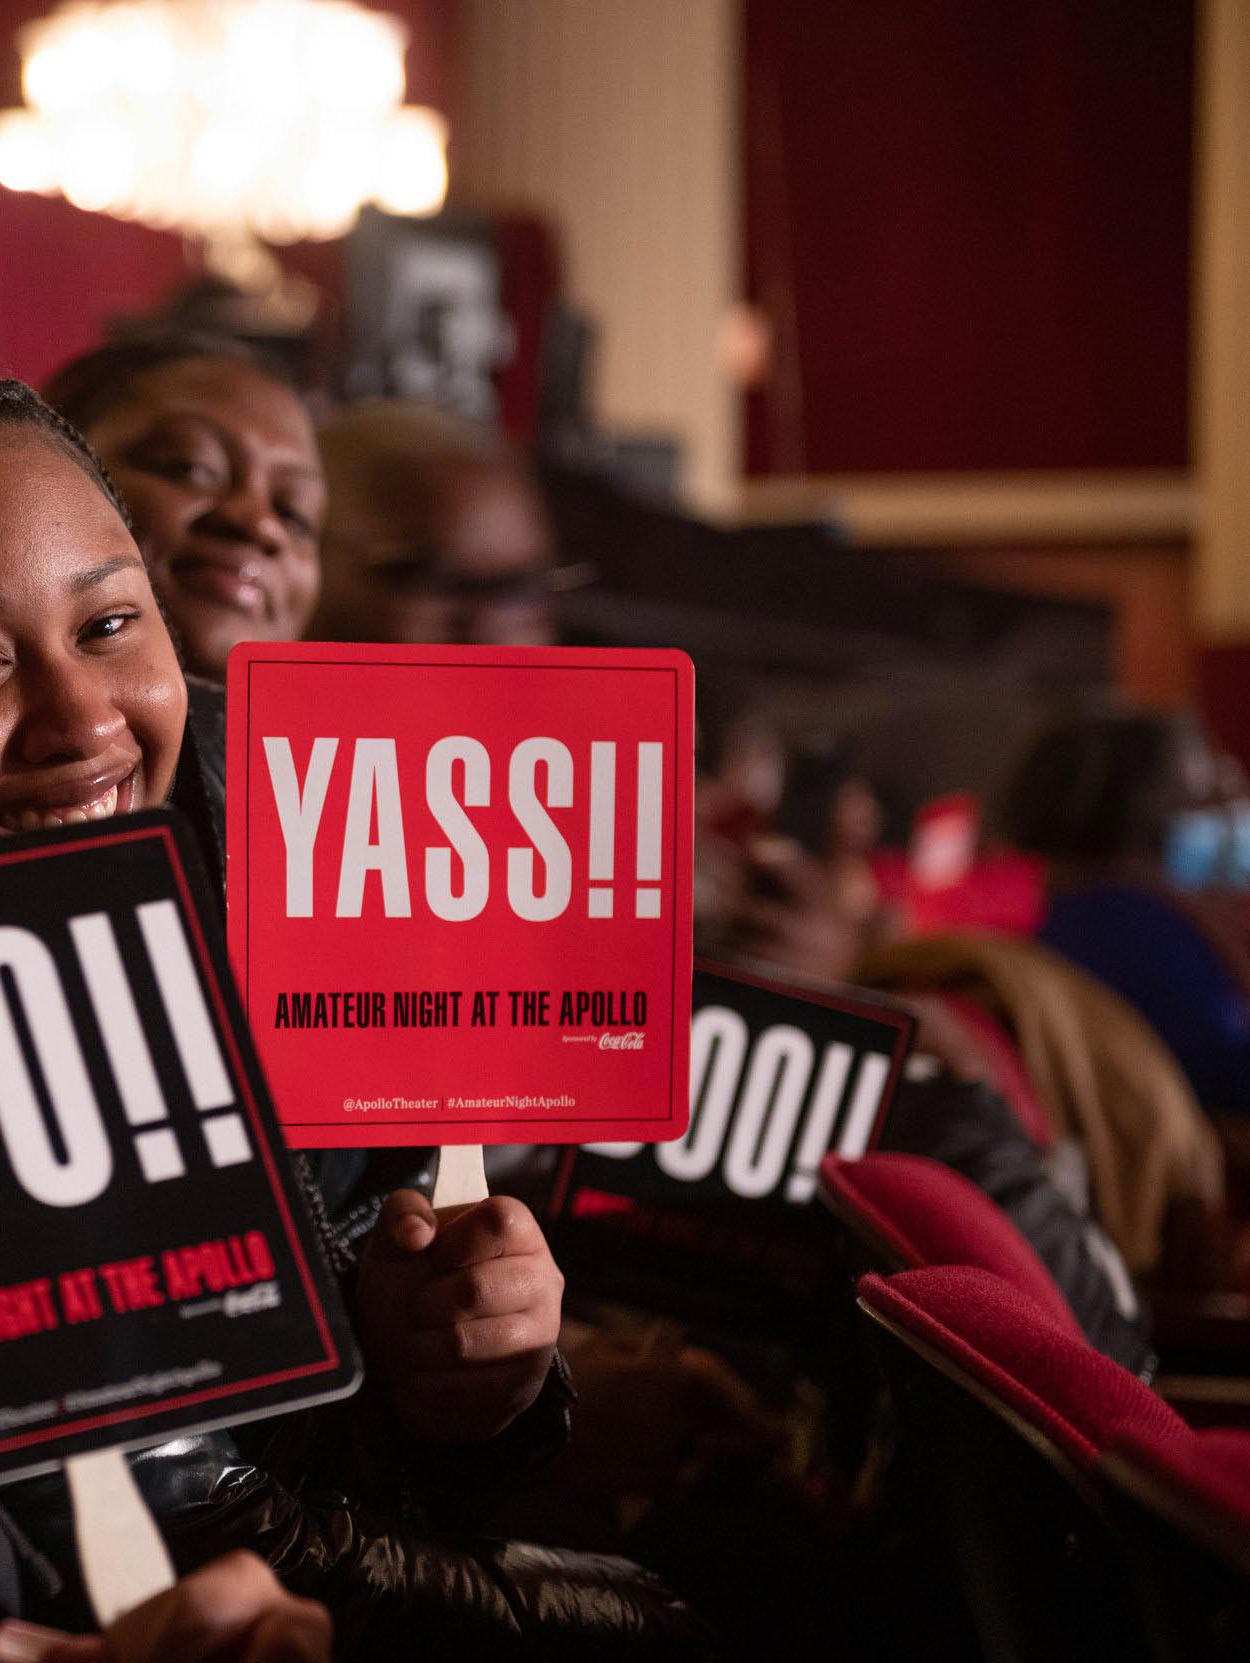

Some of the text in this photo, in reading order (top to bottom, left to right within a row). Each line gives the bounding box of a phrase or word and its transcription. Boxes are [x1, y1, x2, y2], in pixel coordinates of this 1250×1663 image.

[261, 735, 664, 923] YASS!!
[275, 991, 648, 1029] AMATEUR NIGHT AT THE APOLLO
[343, 1095, 576, 1113] @ApolloTheater #AmateurNightApollo
[59, 1268, 104, 1325] AT
[100, 1255, 166, 1314] THE
[161, 1229, 276, 1301] APOLLO
